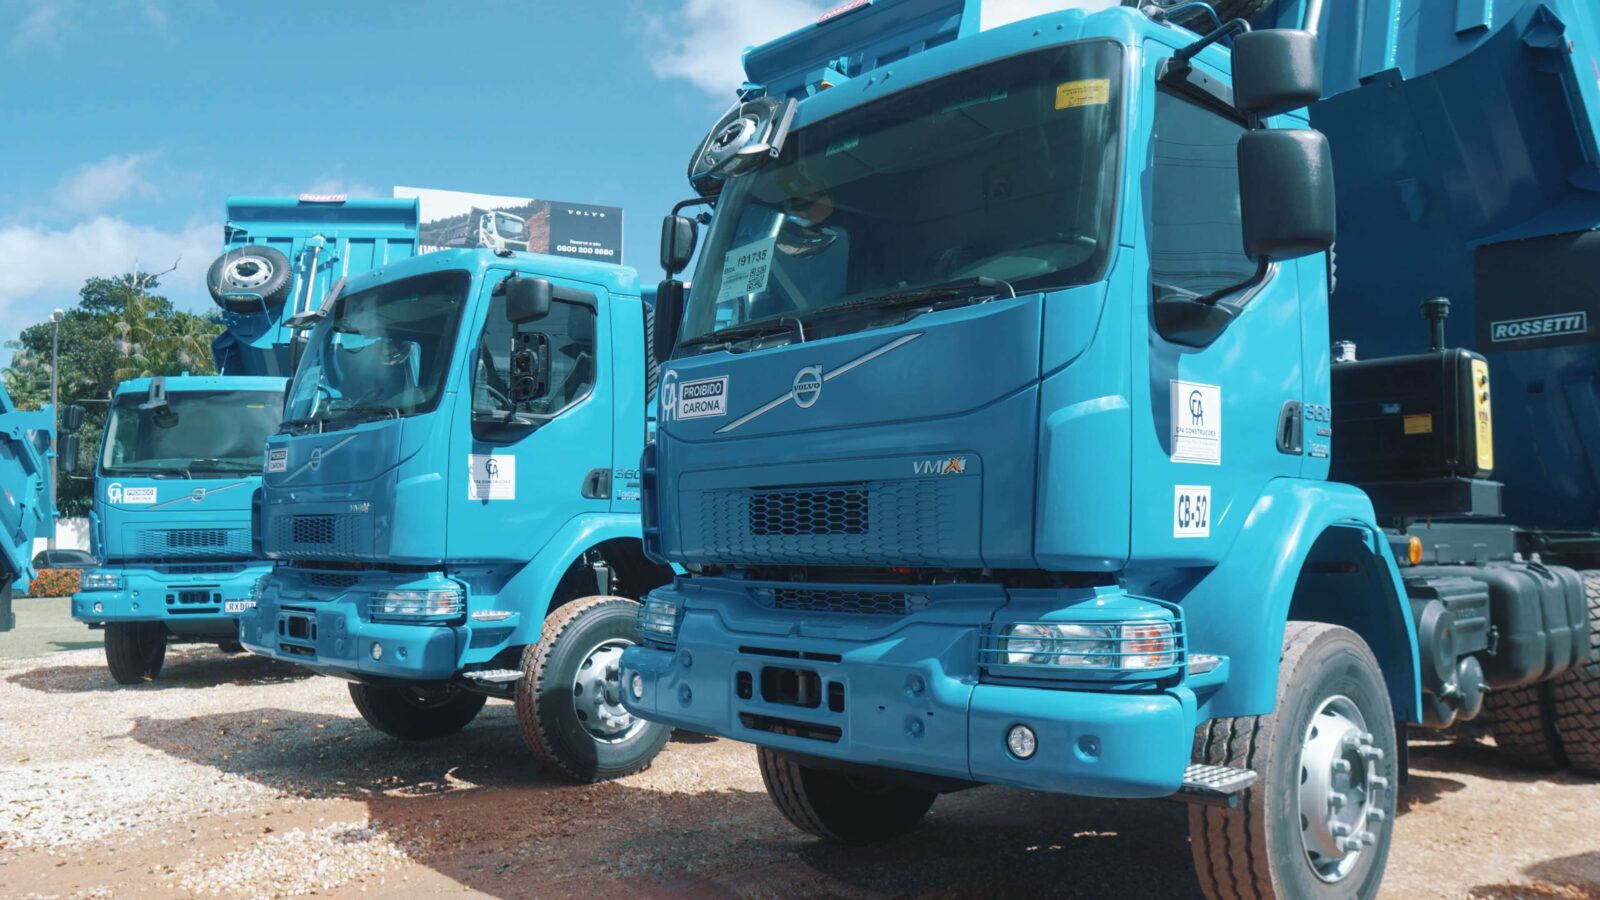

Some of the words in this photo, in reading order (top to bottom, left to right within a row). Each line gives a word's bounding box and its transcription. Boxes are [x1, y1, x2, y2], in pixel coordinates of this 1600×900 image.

[568, 209, 606, 218] VOLVO
[578, 246, 593, 254] 200
[737, 249, 768, 268] 191735
[1495, 316, 1581, 338] ROSSETTI
[683, 382, 722, 398] PROIBIDO
[794, 382, 820, 391] VOLVO
[683, 400, 720, 414] CARONA
[1178, 494, 1207, 528] CB-52
